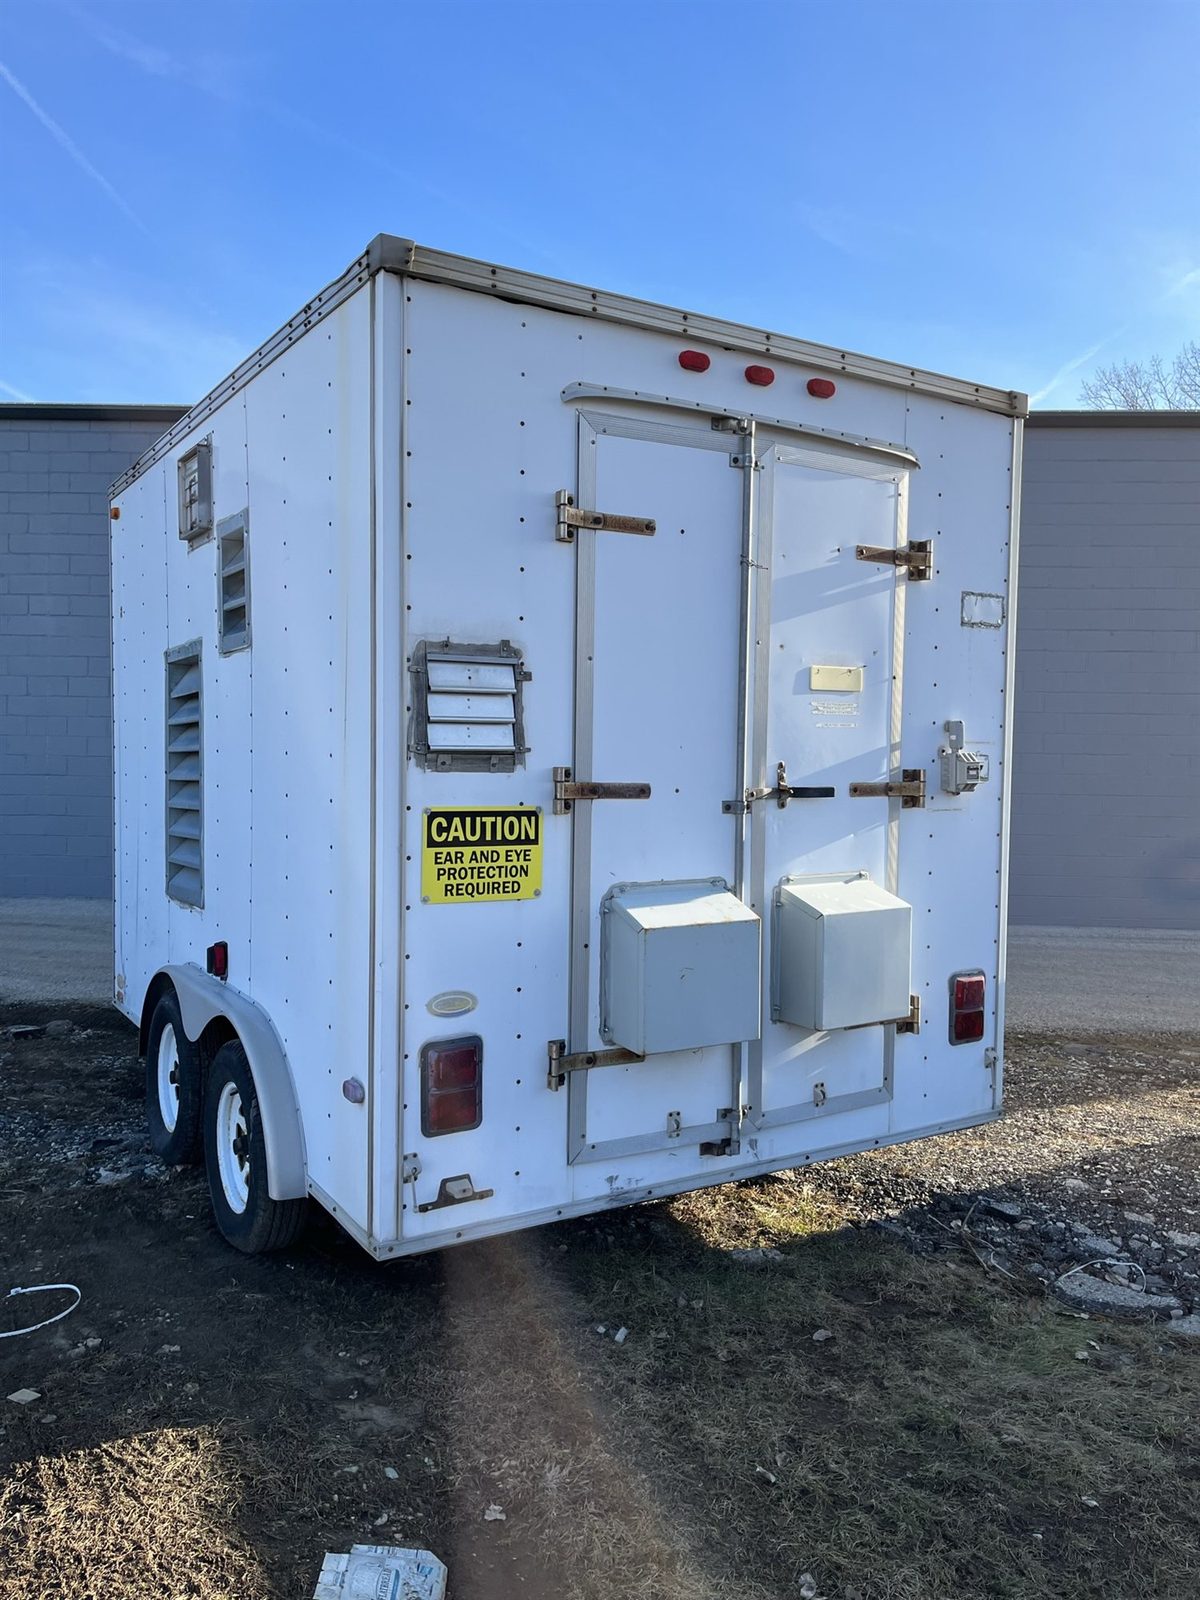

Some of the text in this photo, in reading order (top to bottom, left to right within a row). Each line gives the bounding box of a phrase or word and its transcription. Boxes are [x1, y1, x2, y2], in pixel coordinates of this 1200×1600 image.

[431, 816, 536, 842] CAUTION
[434, 849, 532, 865] EAR AND EYE
[437, 865, 529, 881] PROTECTION
[444, 881, 521, 897] REQUIRED
